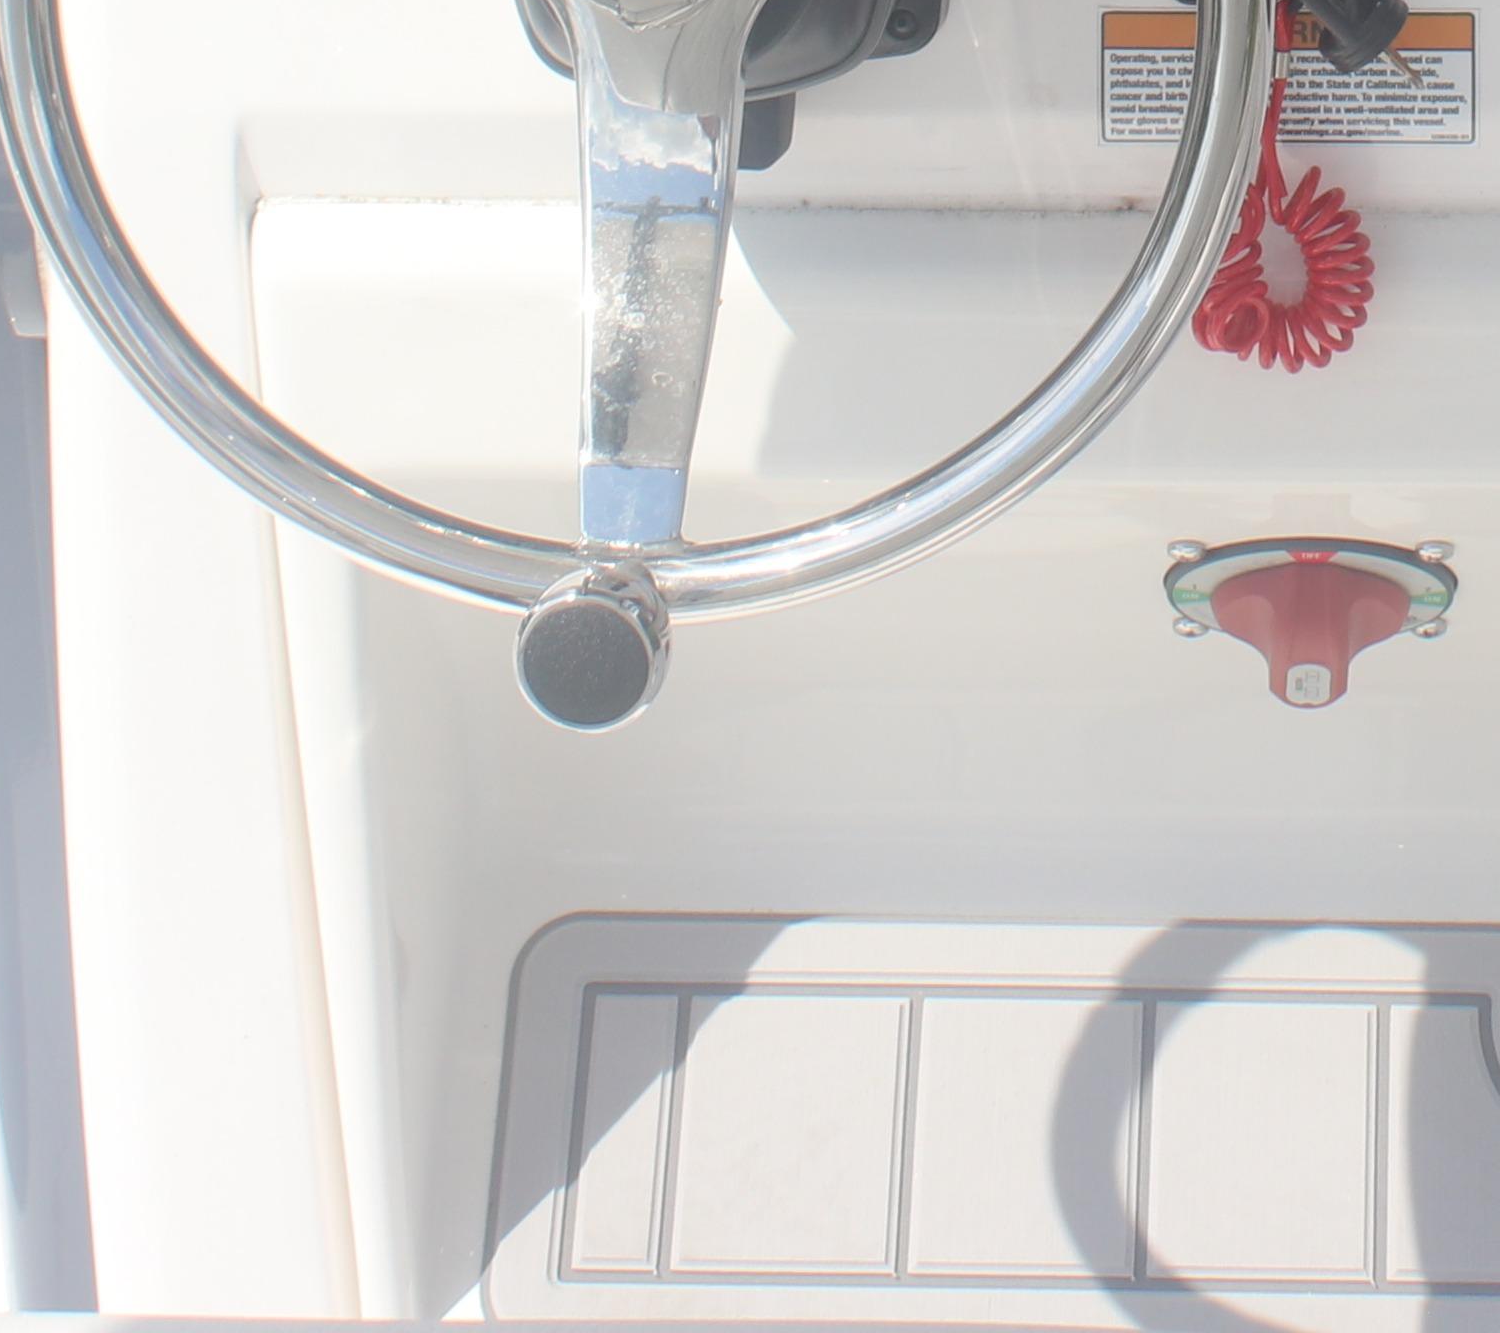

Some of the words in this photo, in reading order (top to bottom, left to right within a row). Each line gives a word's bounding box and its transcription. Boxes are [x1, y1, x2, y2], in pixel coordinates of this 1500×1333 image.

[1308, 80, 1324, 89] the
[1326, 80, 1352, 89] State
[1354, 80, 1364, 89] of
[1145, 92, 1162, 101] and
[1164, 92, 1187, 101] birth
[1332, 93, 1359, 102] harm.
[1362, 94, 1373, 102] To
[1375, 94, 1419, 103] minimize
[1421, 95, 1467, 104] exposure,
[1110, 104, 1136, 113] avoid
[1138, 104, 1184, 115] breathing
[1325, 105, 1333, 114] in
[1344, 106, 1416, 114] well-ventilated
[1442, 106, 1460, 115] and
